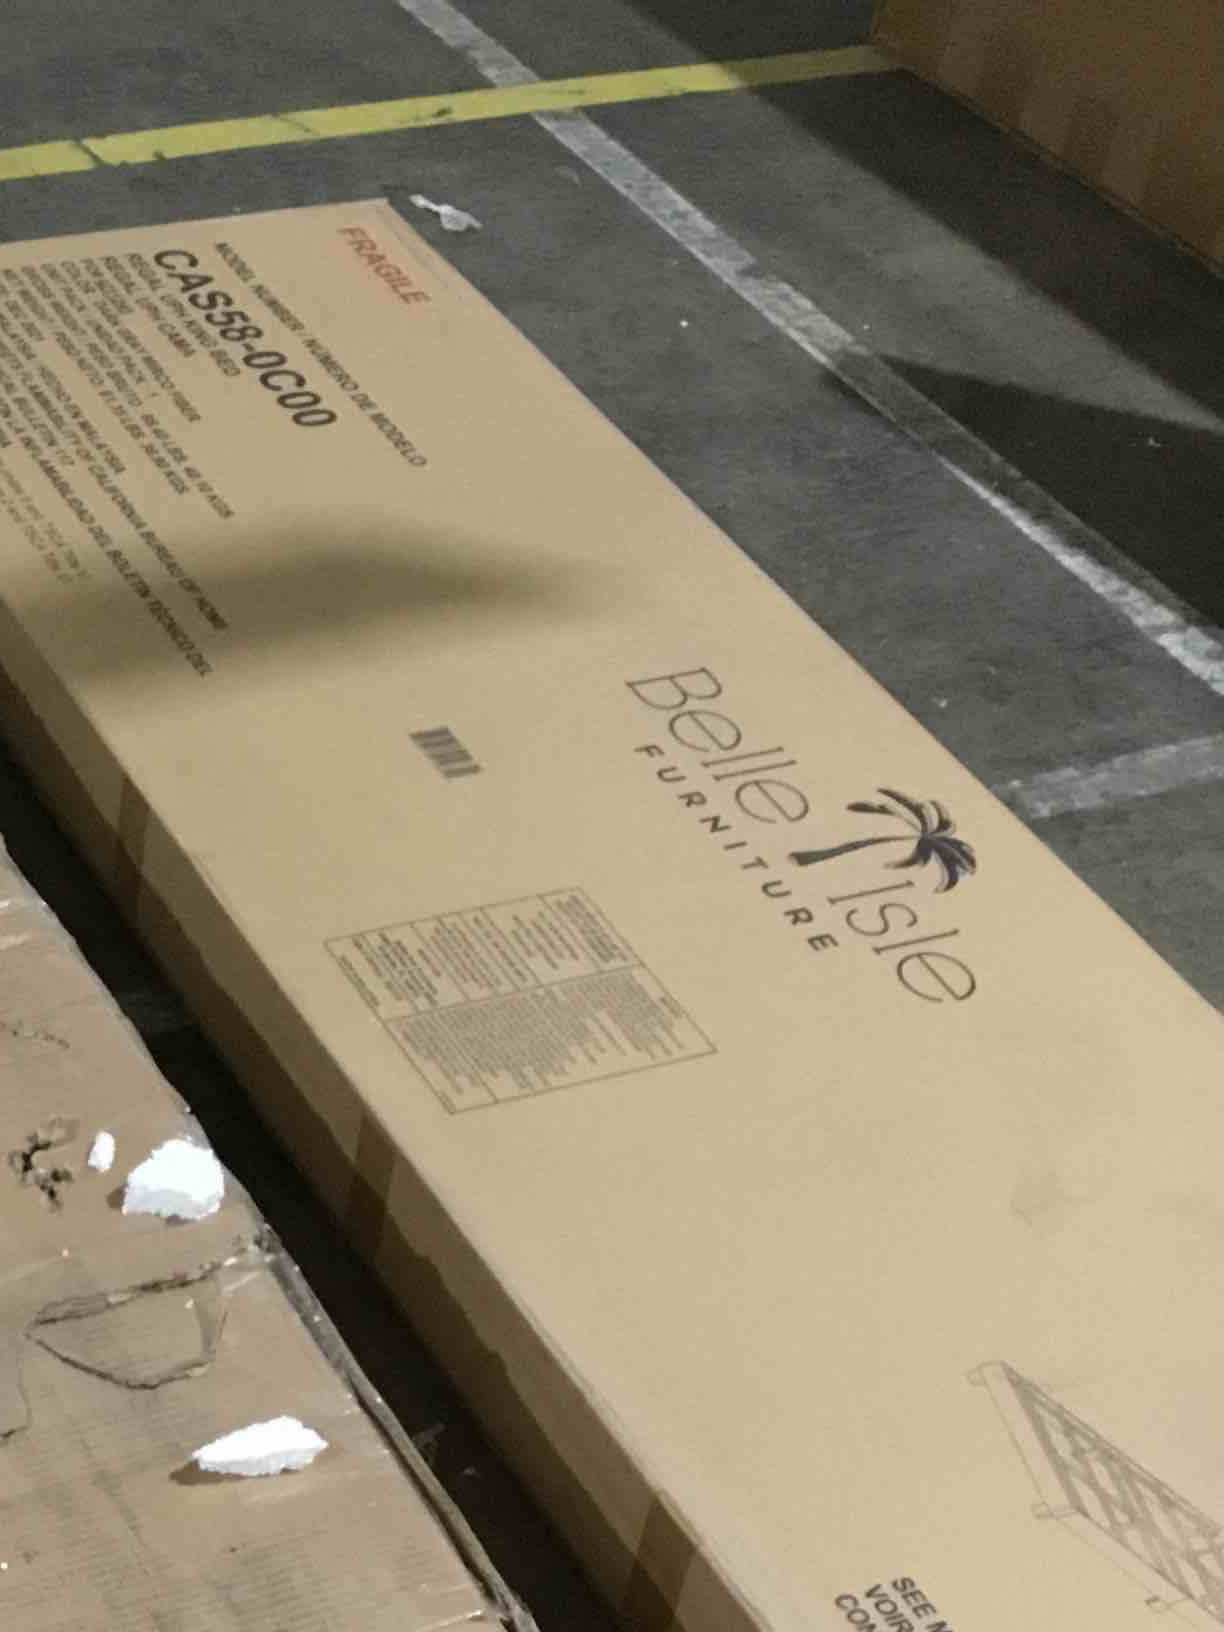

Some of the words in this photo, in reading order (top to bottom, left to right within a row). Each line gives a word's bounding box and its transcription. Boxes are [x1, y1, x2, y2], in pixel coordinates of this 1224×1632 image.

[337, 227, 432, 304] FRAGILE
[154, 249, 338, 428] CAS58-0C00
[158, 324, 196, 357] CAMA
[351, 394, 377, 411] DE
[371, 413, 427, 466] MODELO
[625, 667, 810, 823] Belle
[827, 880, 977, 1003] Isle
[634, 744, 840, 951] FURNITURE
[892, 1576, 937, 1619] SEE
